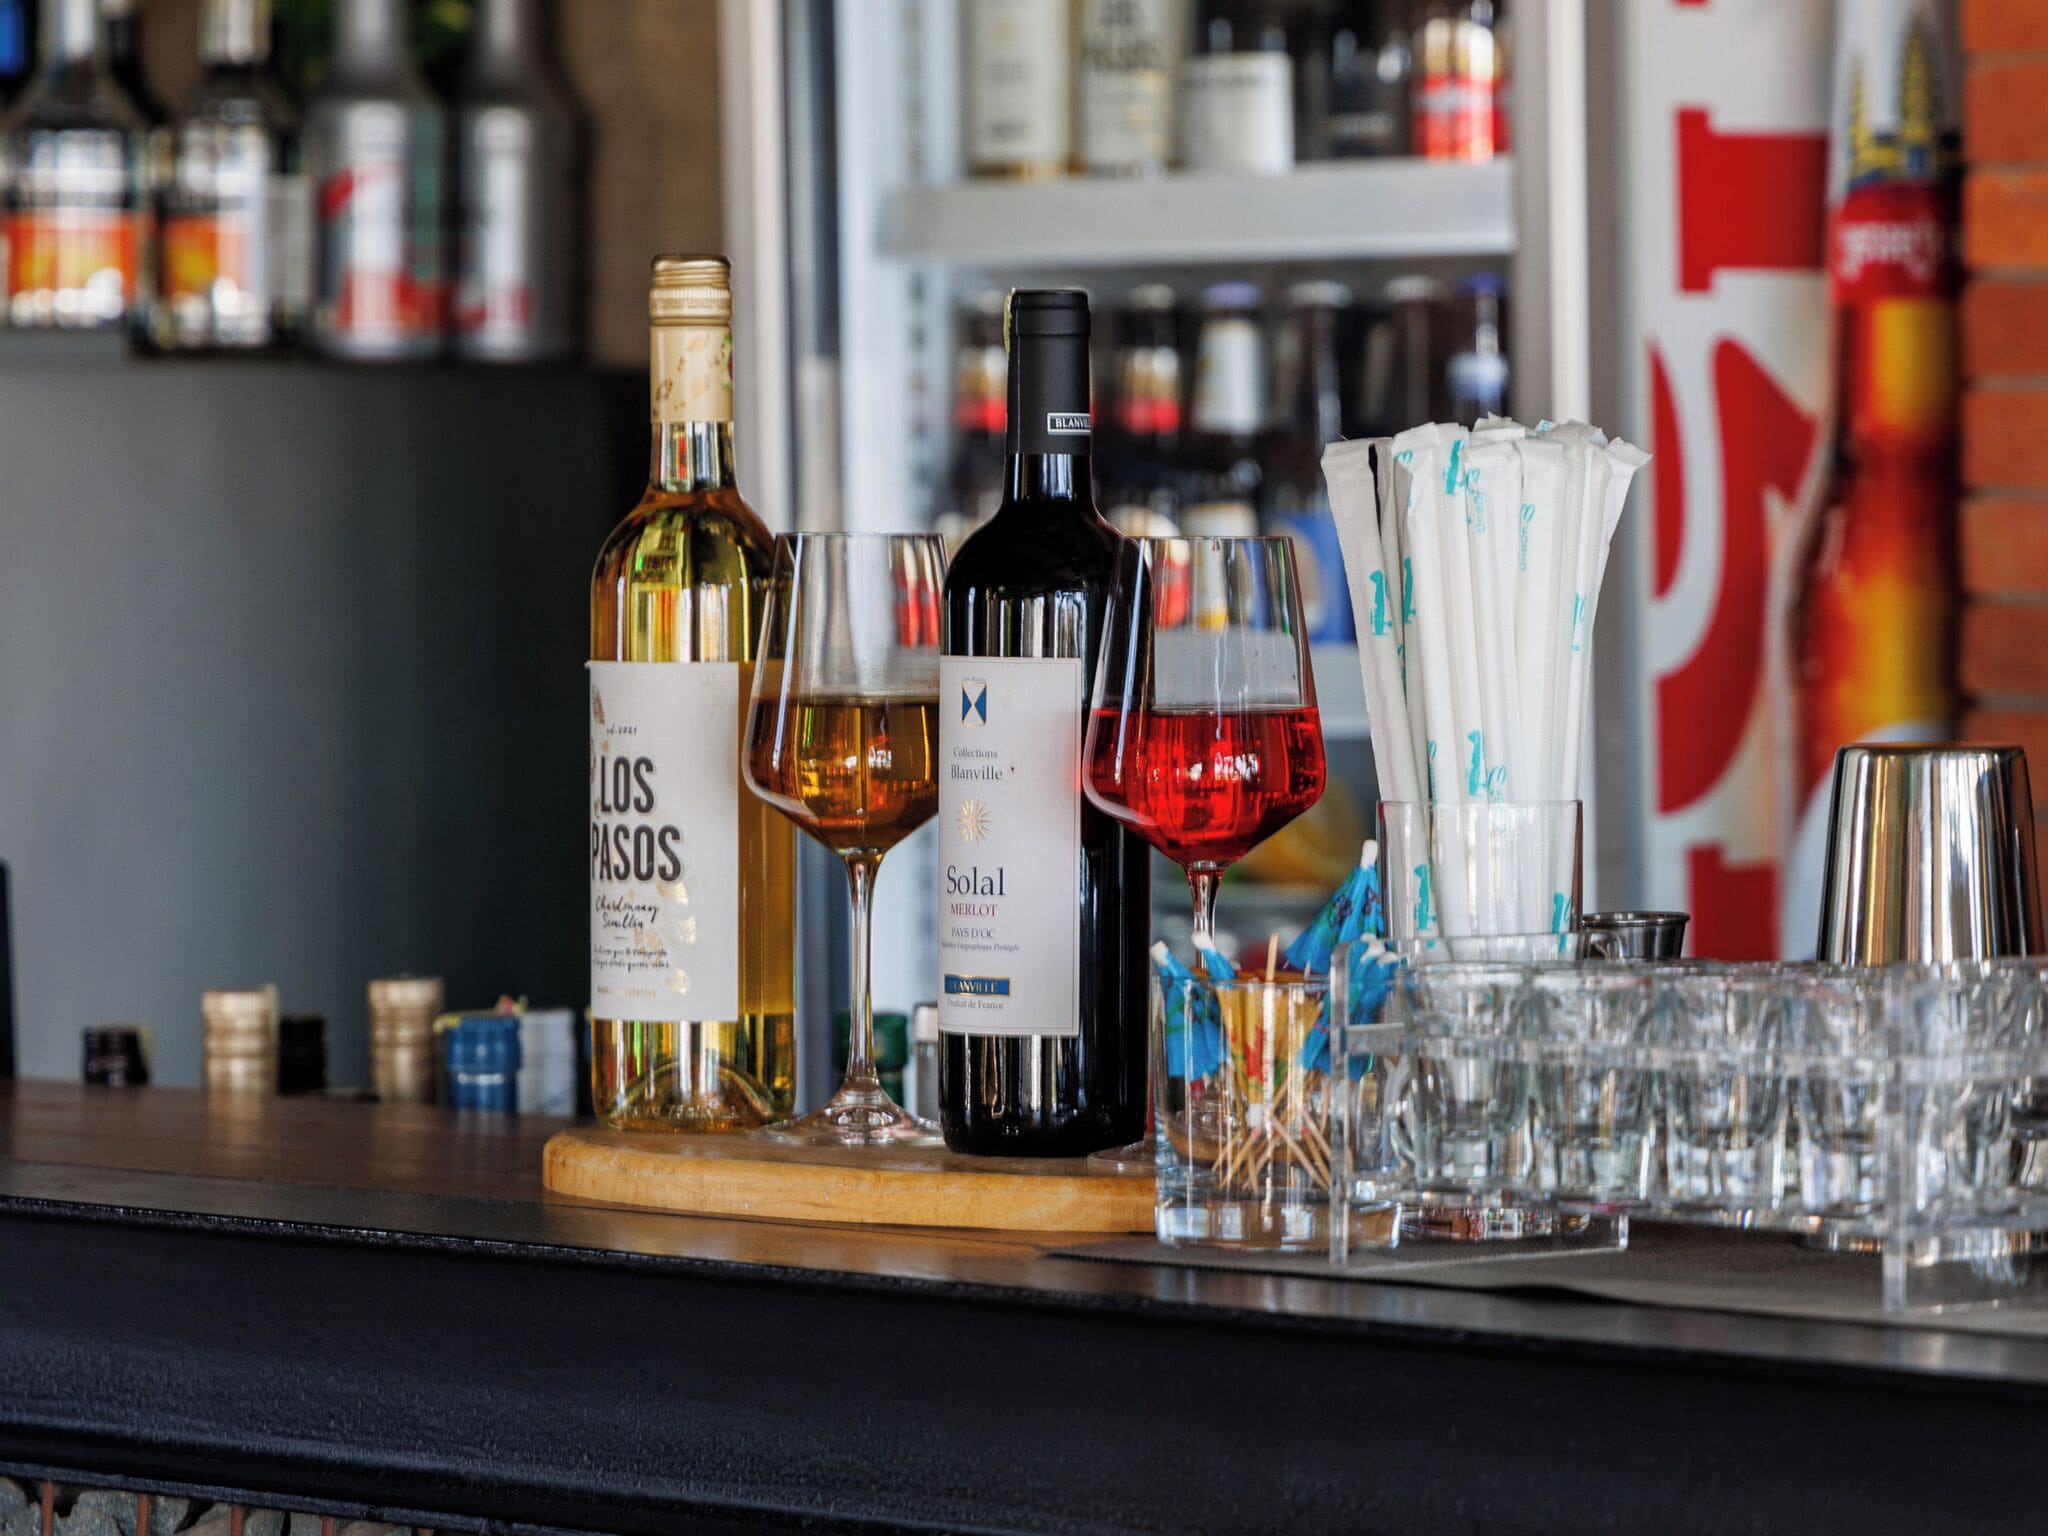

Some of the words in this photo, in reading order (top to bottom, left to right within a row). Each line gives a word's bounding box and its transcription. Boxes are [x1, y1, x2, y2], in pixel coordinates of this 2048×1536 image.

[953, 746, 999, 759] Collections
[950, 764, 1003, 780] Blanville
[600, 755, 654, 813] LOS
[591, 822, 681, 881] PASOS
[946, 865, 1006, 896] Solal
[595, 894, 659, 923] Chardonnay
[950, 902, 997, 917] MERLOT
[951, 927, 970, 938] PAYS
[971, 927, 997, 939] D'OC
[968, 999, 977, 1009] de
[978, 1000, 1004, 1010] France
